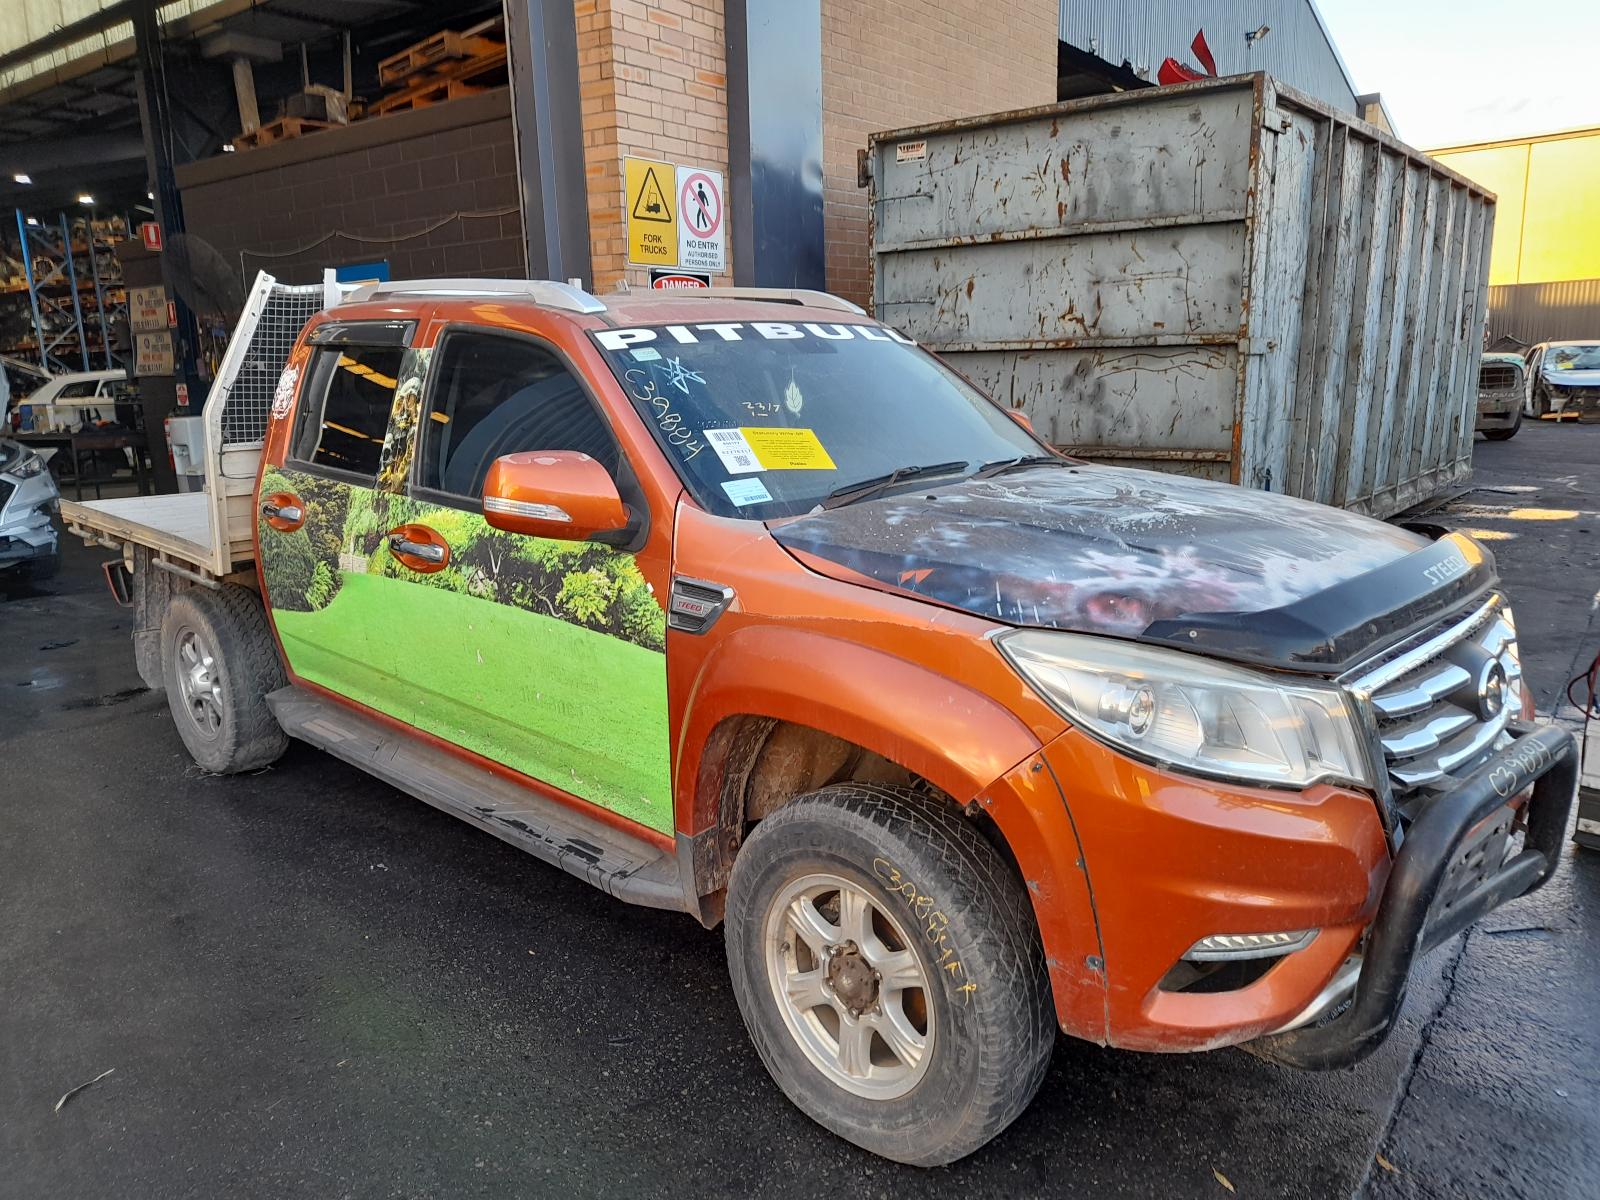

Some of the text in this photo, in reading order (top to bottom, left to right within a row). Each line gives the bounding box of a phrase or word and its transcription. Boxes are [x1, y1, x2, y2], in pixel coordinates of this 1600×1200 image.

[643, 233, 663, 244] FORK
[640, 244, 668, 256] TRUCKS
[686, 239, 719, 251] NO ENTRY
[687, 250, 719, 260] AUTHORISED
[685, 259, 708, 267] PERSONS
[594, 322, 918, 351] PITBULL
[1423, 555, 1465, 586] STEED
